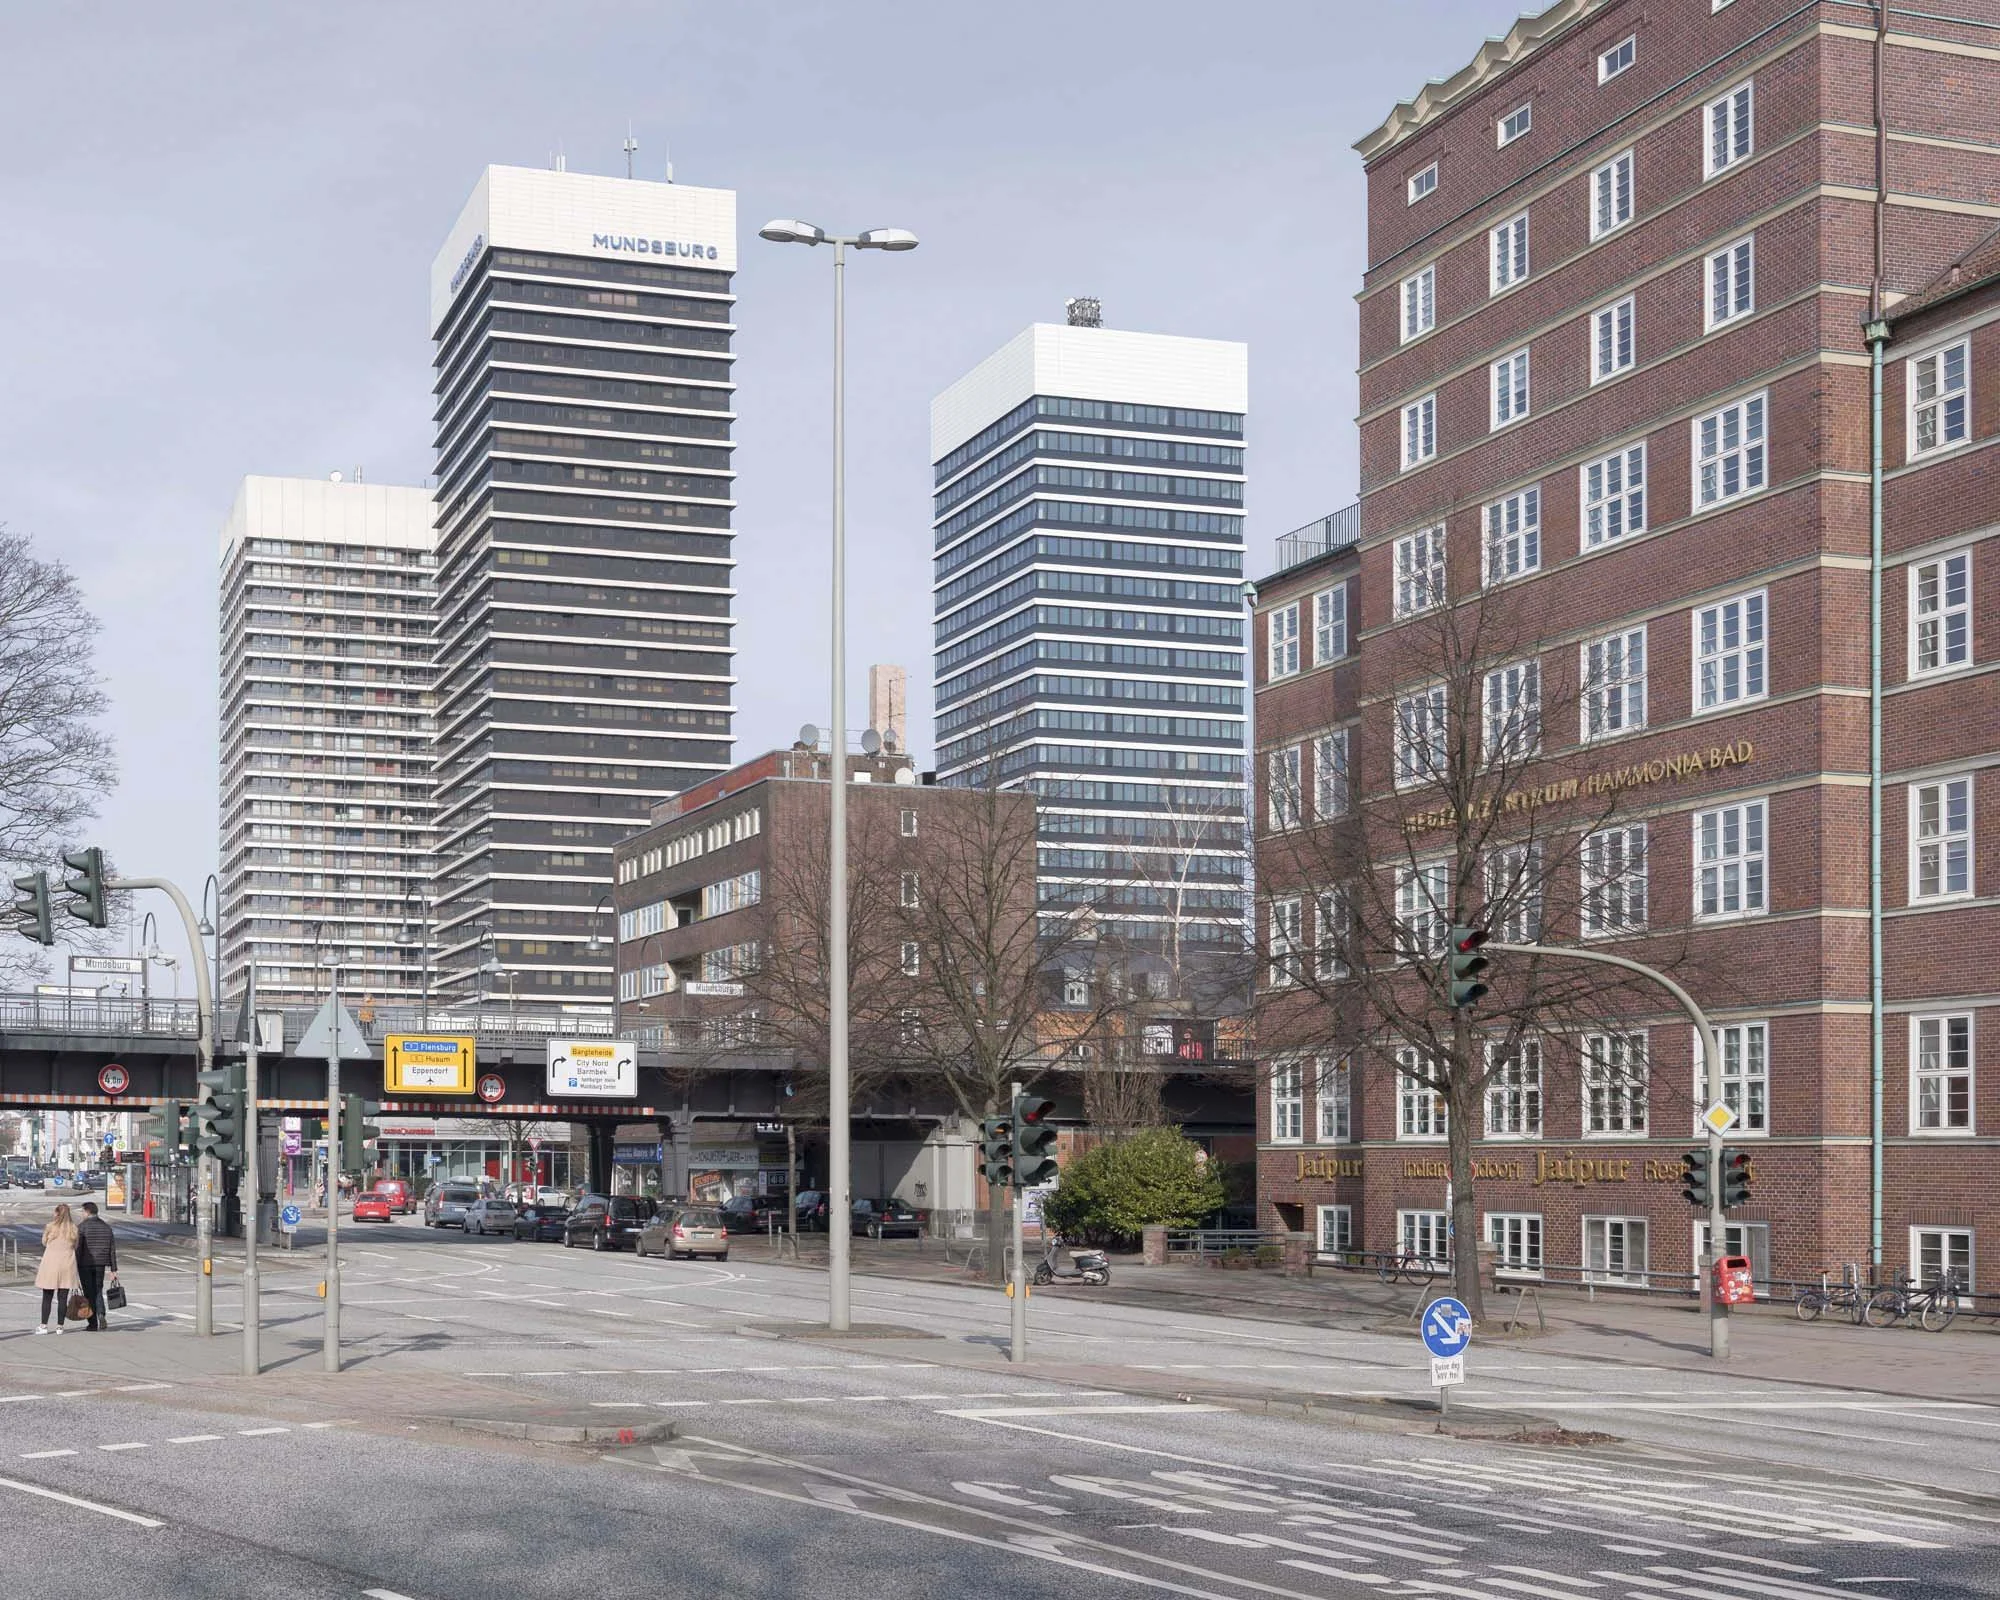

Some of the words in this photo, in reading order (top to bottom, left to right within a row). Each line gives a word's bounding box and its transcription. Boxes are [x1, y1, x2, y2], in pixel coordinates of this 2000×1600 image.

[592, 233, 718, 260] MUNDSBURG
[1587, 750, 1704, 794] HAMMONIA
[1709, 739, 1753, 769] BAD
[85, 959, 131, 971] Mundsburg
[420, 1043, 457, 1053] Flensburg
[425, 1055, 451, 1063] Husum
[576, 1059, 590, 1067] City
[412, 1066, 448, 1075] Eppendorf
[577, 1067, 607, 1075] Barmbek
[1294, 1151, 1363, 1184] Jaipur
[1403, 1157, 1448, 1179] Indian
[1532, 1149, 1631, 1189] Jaipur
